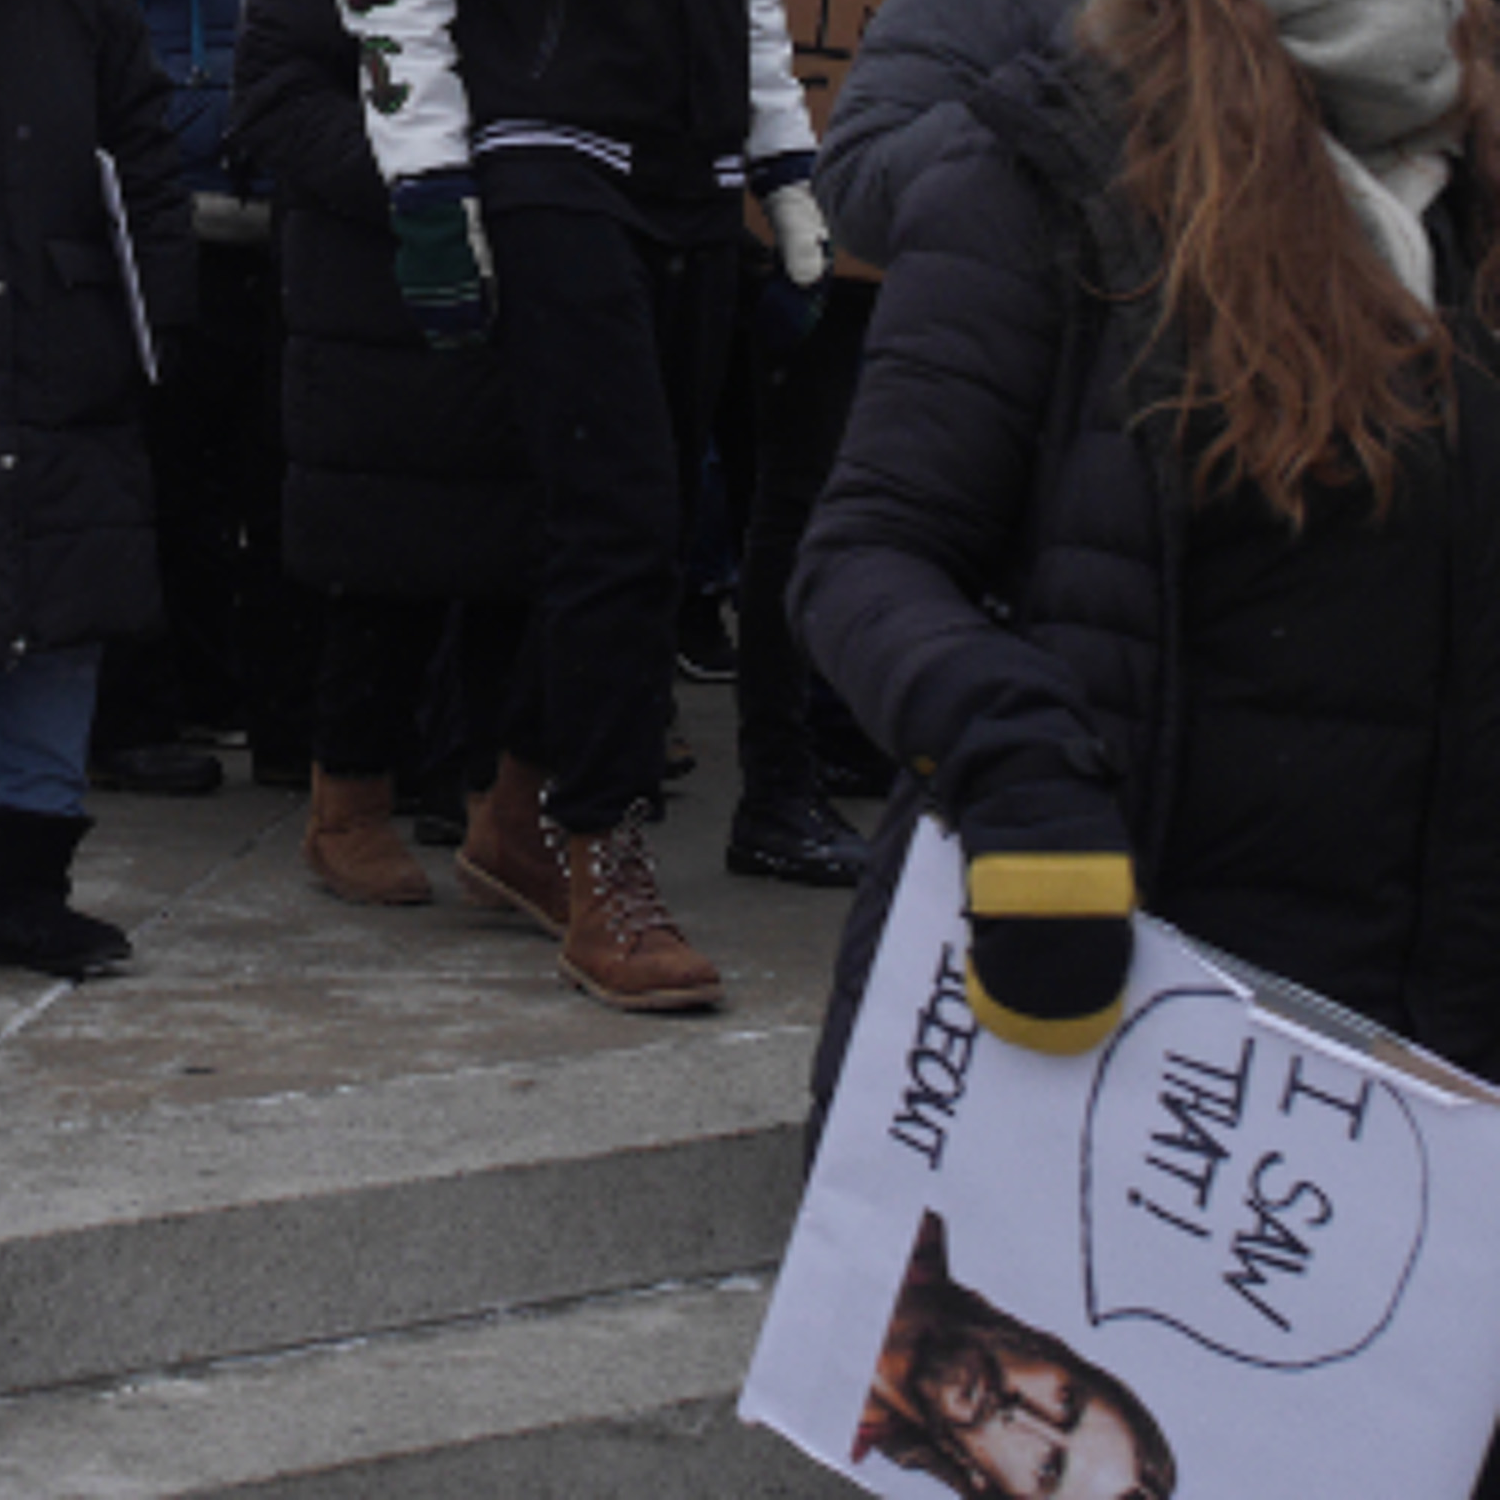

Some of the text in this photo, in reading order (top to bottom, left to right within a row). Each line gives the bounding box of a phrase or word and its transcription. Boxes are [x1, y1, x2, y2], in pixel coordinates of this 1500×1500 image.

[1126, 1037, 1255, 1239] THAT!
[1222, 1054, 1374, 1333] I SAW
